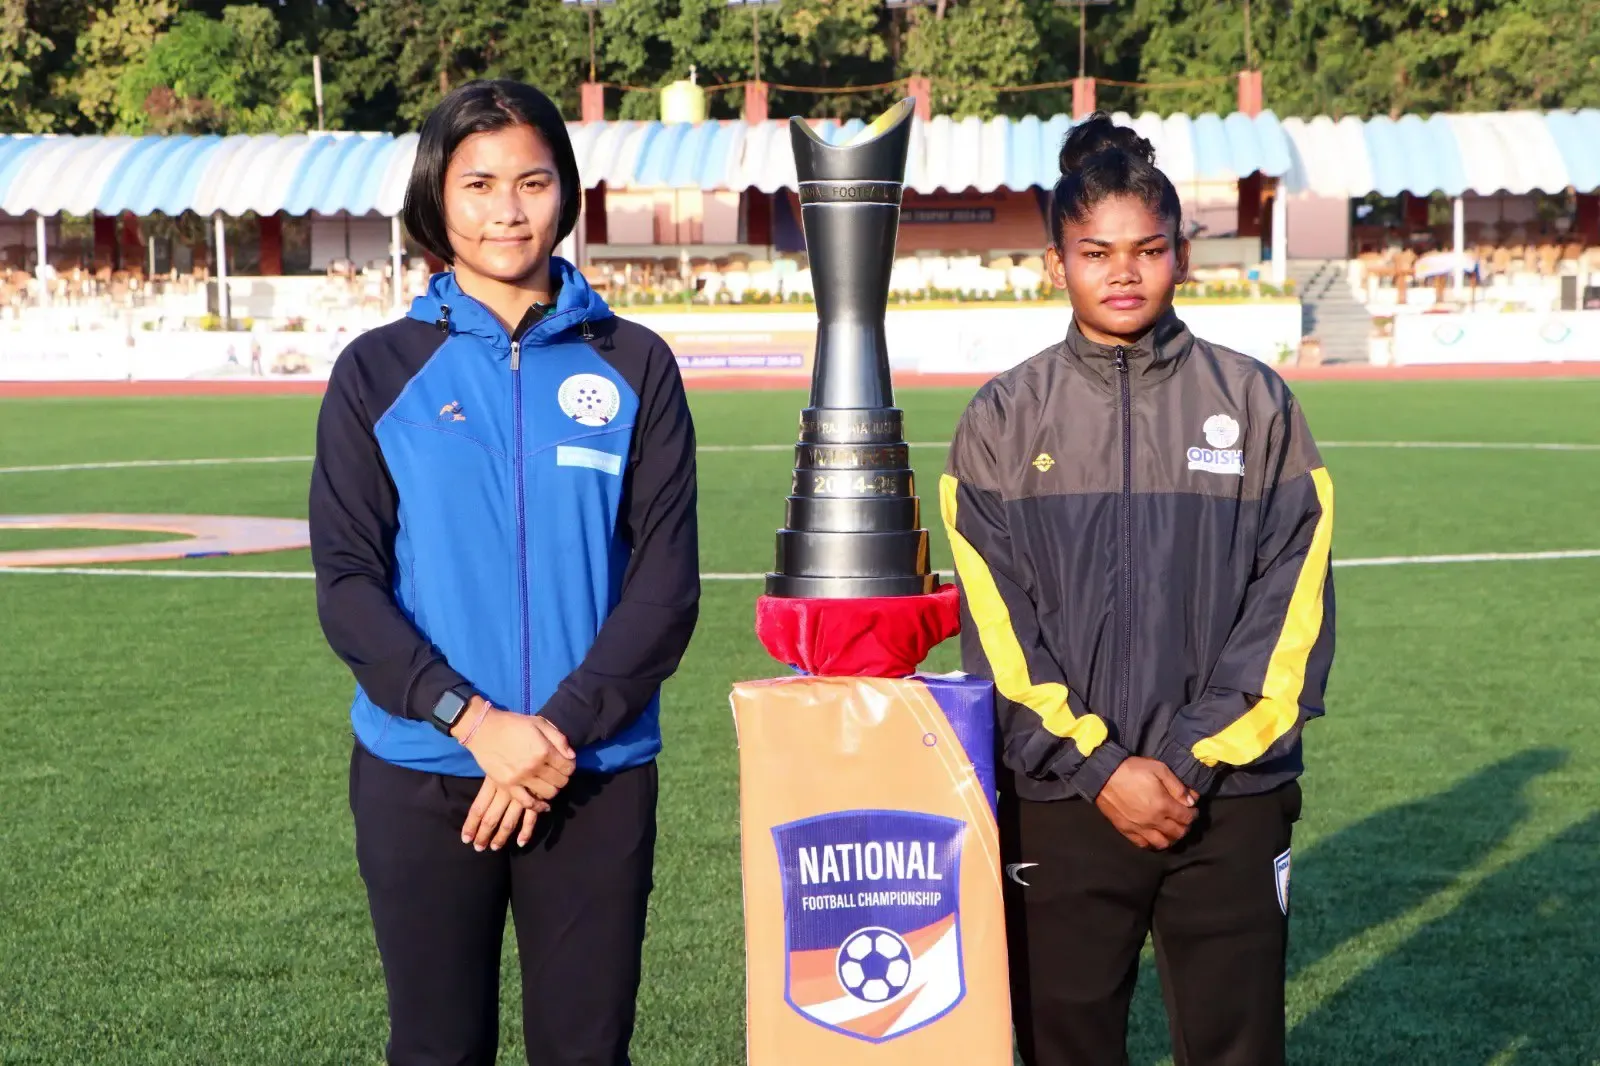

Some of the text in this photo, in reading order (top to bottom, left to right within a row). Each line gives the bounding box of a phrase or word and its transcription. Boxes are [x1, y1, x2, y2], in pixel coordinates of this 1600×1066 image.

[798, 841, 942, 885] NATIONAL
[802, 891, 941, 911] FOOTBALL CHAMPIONSHIP
